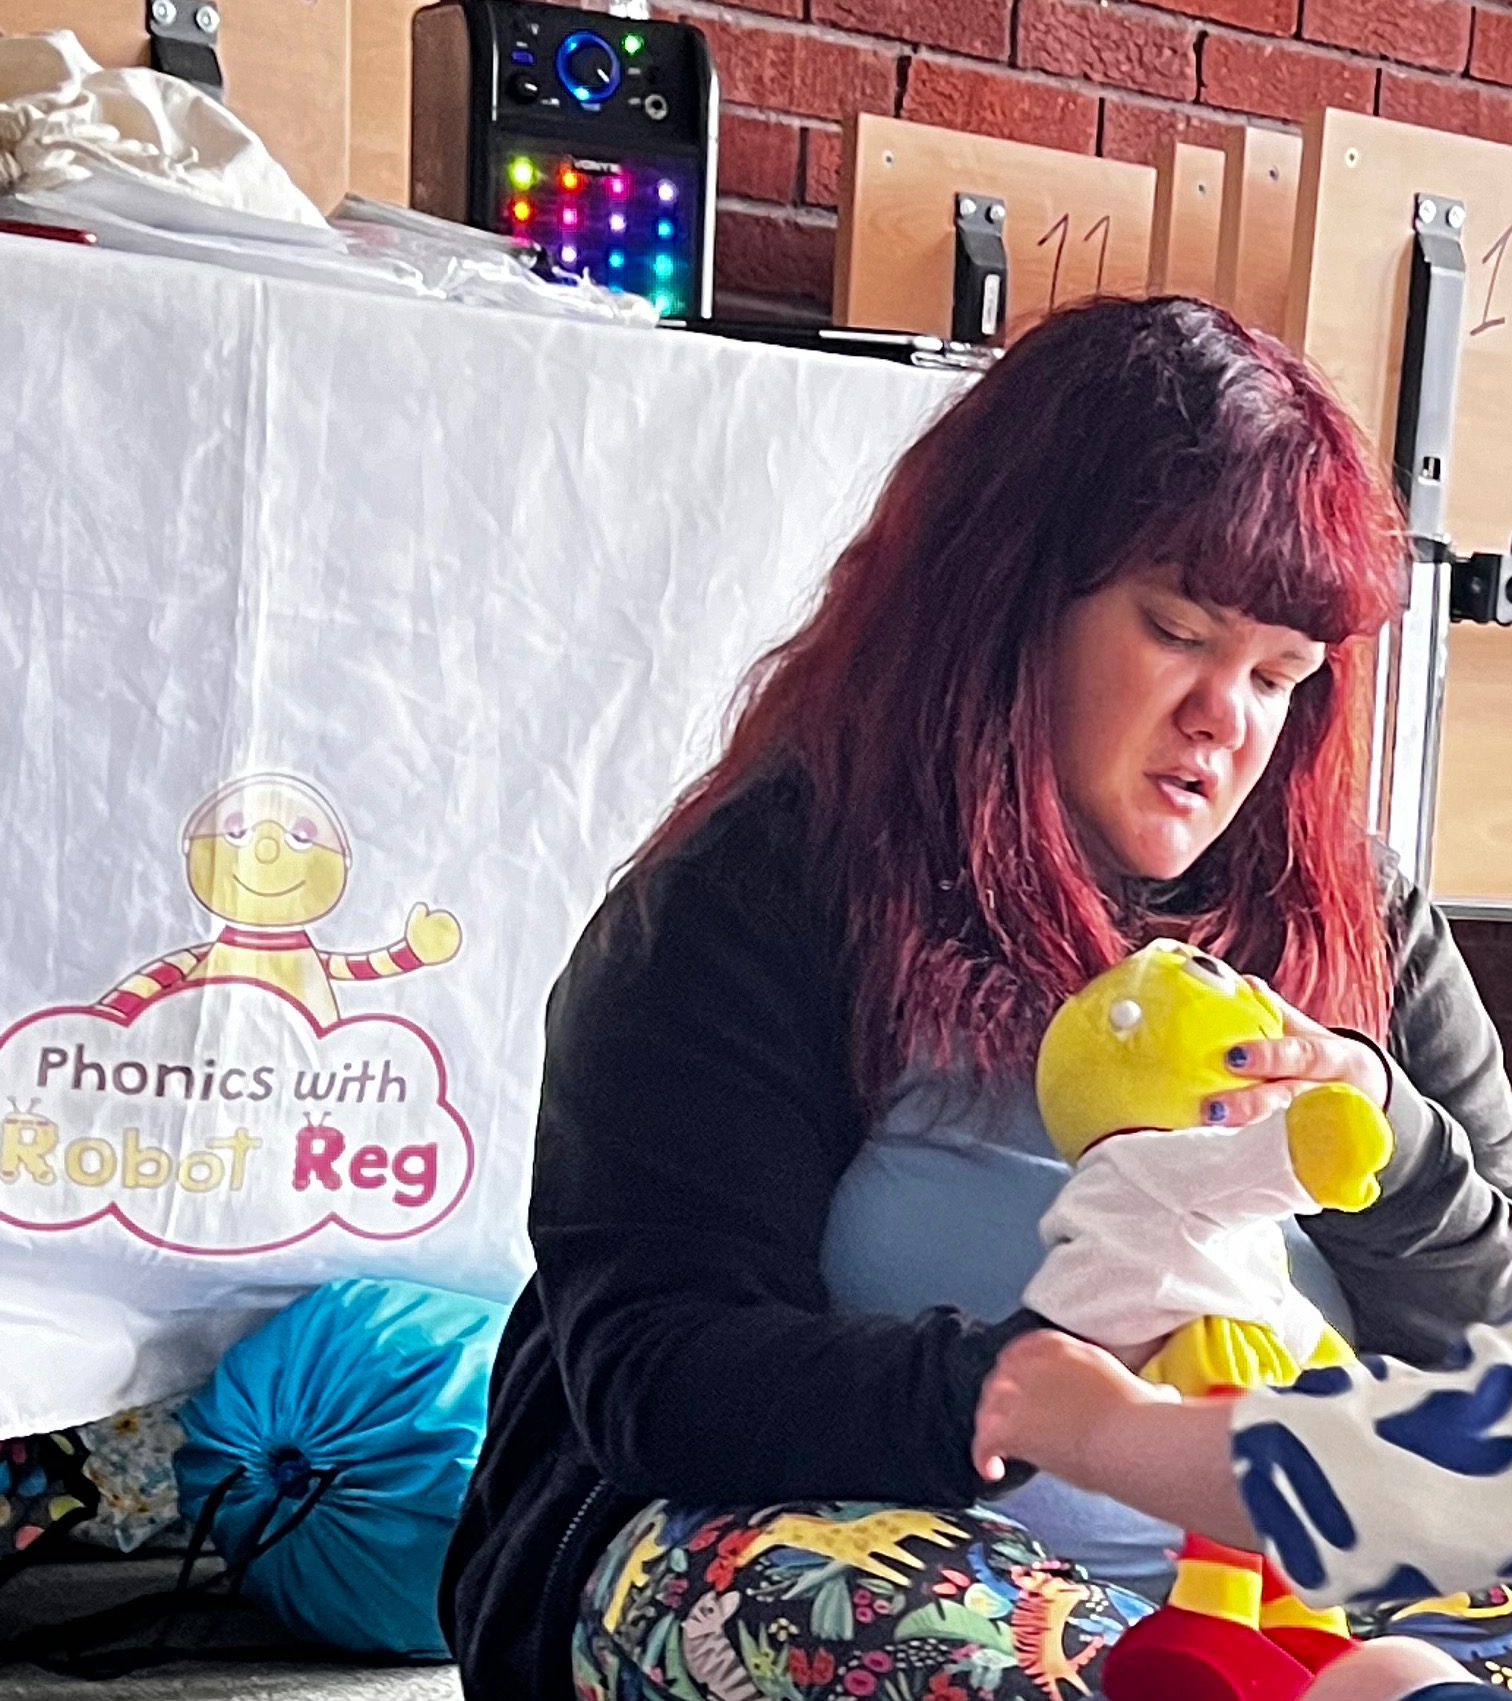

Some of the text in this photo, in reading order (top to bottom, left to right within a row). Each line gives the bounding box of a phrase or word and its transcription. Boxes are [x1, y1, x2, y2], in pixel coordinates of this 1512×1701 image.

[1037, 213, 1111, 310] 11
[37, 1044, 407, 1104] Phonics with
[0, 1100, 438, 1207] Robot Reg
